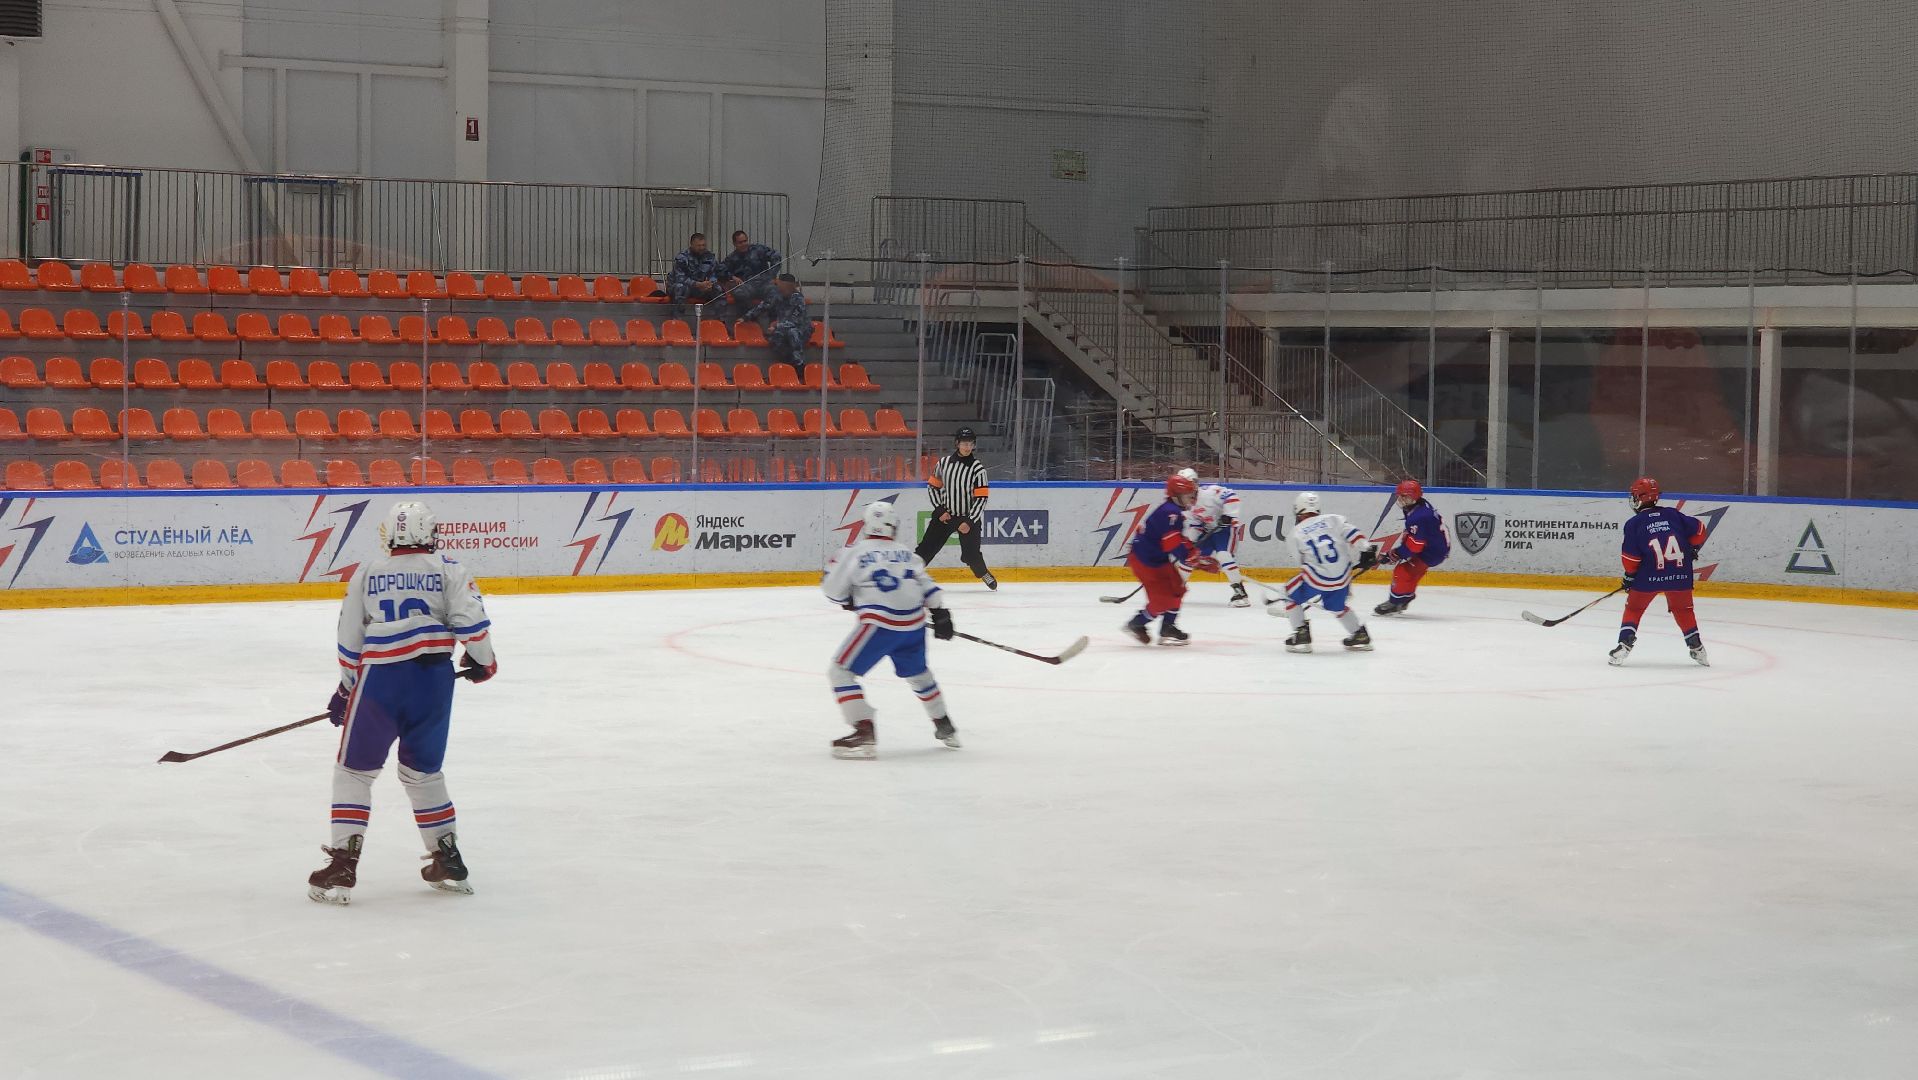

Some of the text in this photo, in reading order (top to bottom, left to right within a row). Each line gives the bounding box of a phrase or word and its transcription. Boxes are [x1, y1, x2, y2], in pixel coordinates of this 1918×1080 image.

[396, 522, 407, 532] 16
[436, 521, 506, 534] ЕДЕРАЦИЯ
[696, 515, 745, 529] Яндекс
[1504, 519, 1619, 530] КОНТИНЕНТАЛЬНАЯ
[114, 525, 254, 546] СТУДЁНЫЙ ЛЁД
[695, 531, 796, 552] Маркет
[1504, 529, 1575, 540] ХОККЕЙНАЯ
[434, 536, 539, 550] ОККЕЯ РОССИИ
[1306, 534, 1339, 564] 13
[1503, 541, 1533, 550] ЛИГА
[114, 549, 235, 559] ВОЗВЕДЕНИЕ ЛЕДОВЫХ КАТКОВ
[1648, 535, 1685, 570] 14
[367, 572, 443, 597] ДОРОШКОВ
